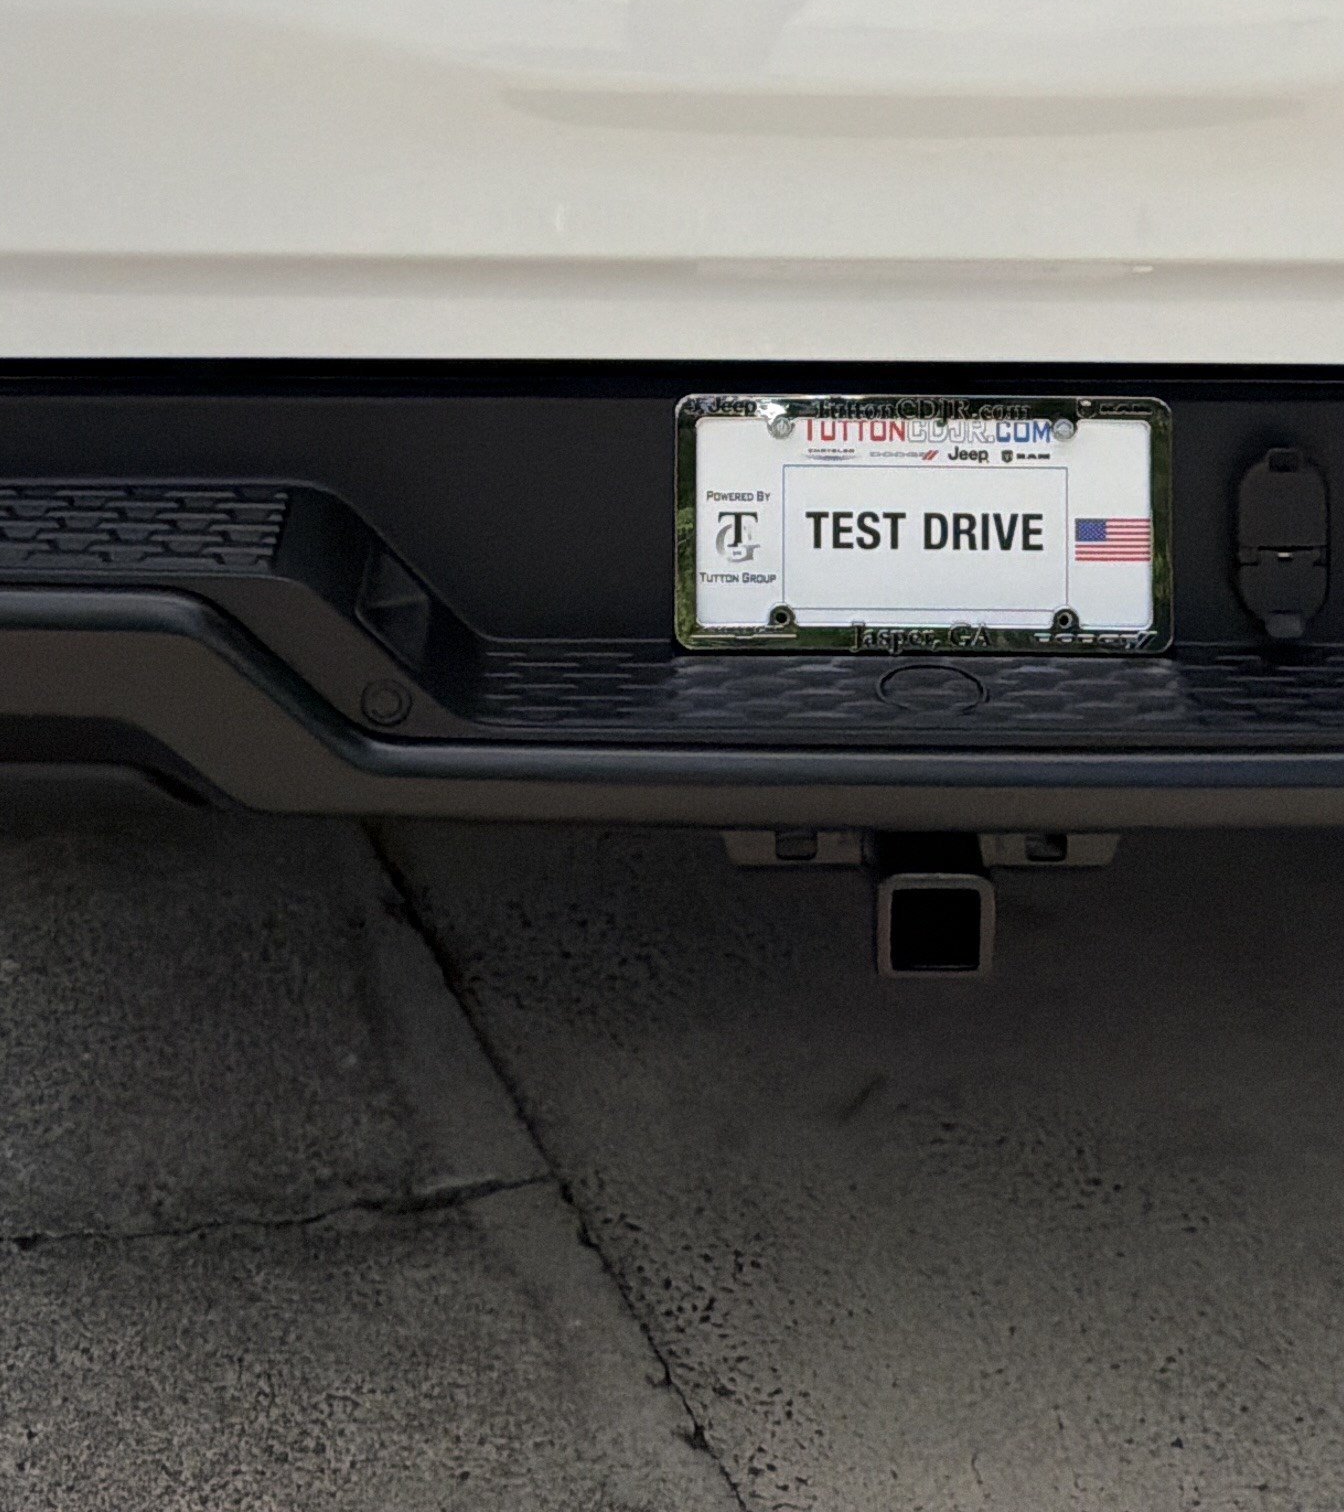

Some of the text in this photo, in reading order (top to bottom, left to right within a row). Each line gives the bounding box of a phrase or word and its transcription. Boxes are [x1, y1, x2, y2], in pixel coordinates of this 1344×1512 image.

[948, 445, 989, 464] Jeep
[1016, 452, 1051, 460] RAM
[805, 510, 1045, 552] TEST DRIVE
[947, 620, 991, 648] GA
